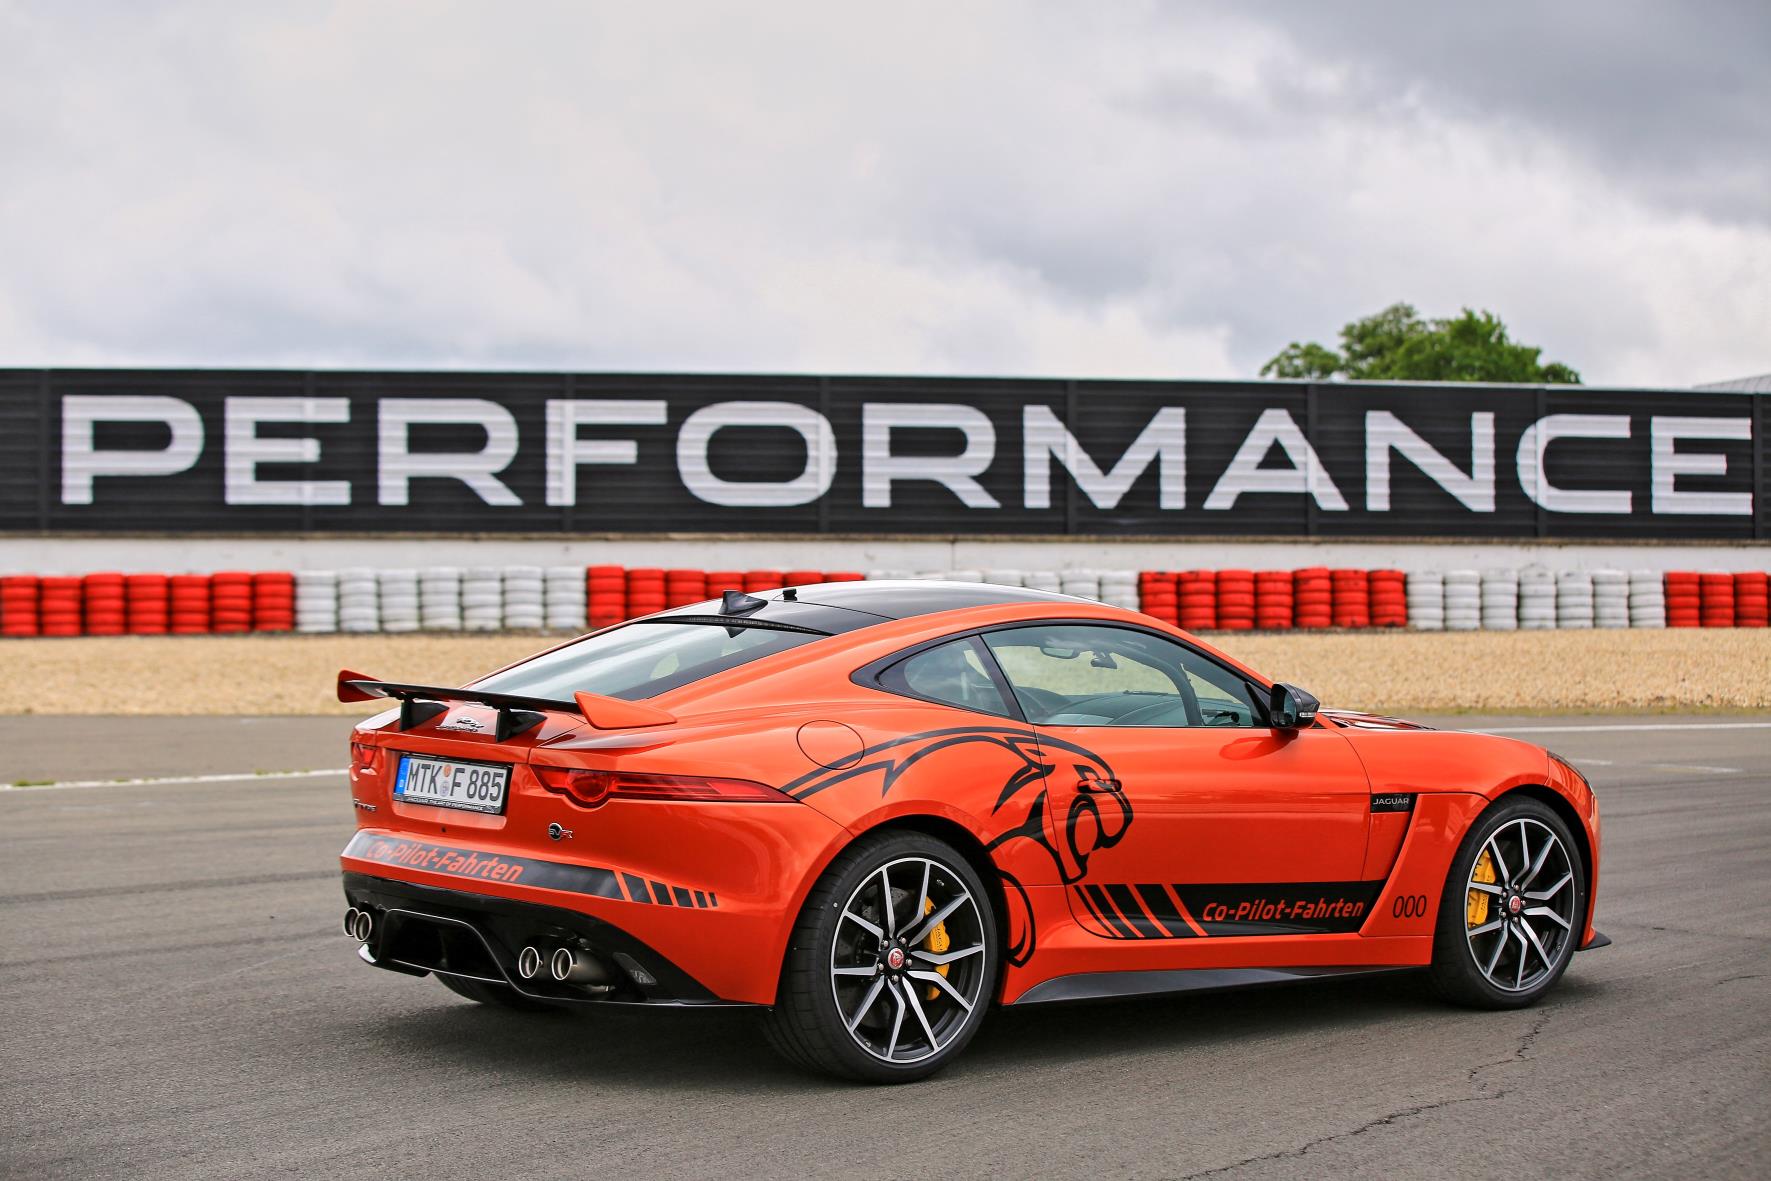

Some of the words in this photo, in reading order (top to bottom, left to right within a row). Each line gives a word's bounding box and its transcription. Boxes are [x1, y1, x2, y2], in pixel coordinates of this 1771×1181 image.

[61, 395, 1753, 515] PERFORMANCE
[406, 762, 442, 794] MTK
[450, 767, 466, 797] F
[467, 769, 505, 802] 885
[1373, 797, 1409, 805] JAGUAR
[367, 840, 524, 882] Co-Pilot-Fahrten
[1202, 897, 1365, 921] Co-Pilot-Fahrten
[1392, 894, 1427, 918] 000
